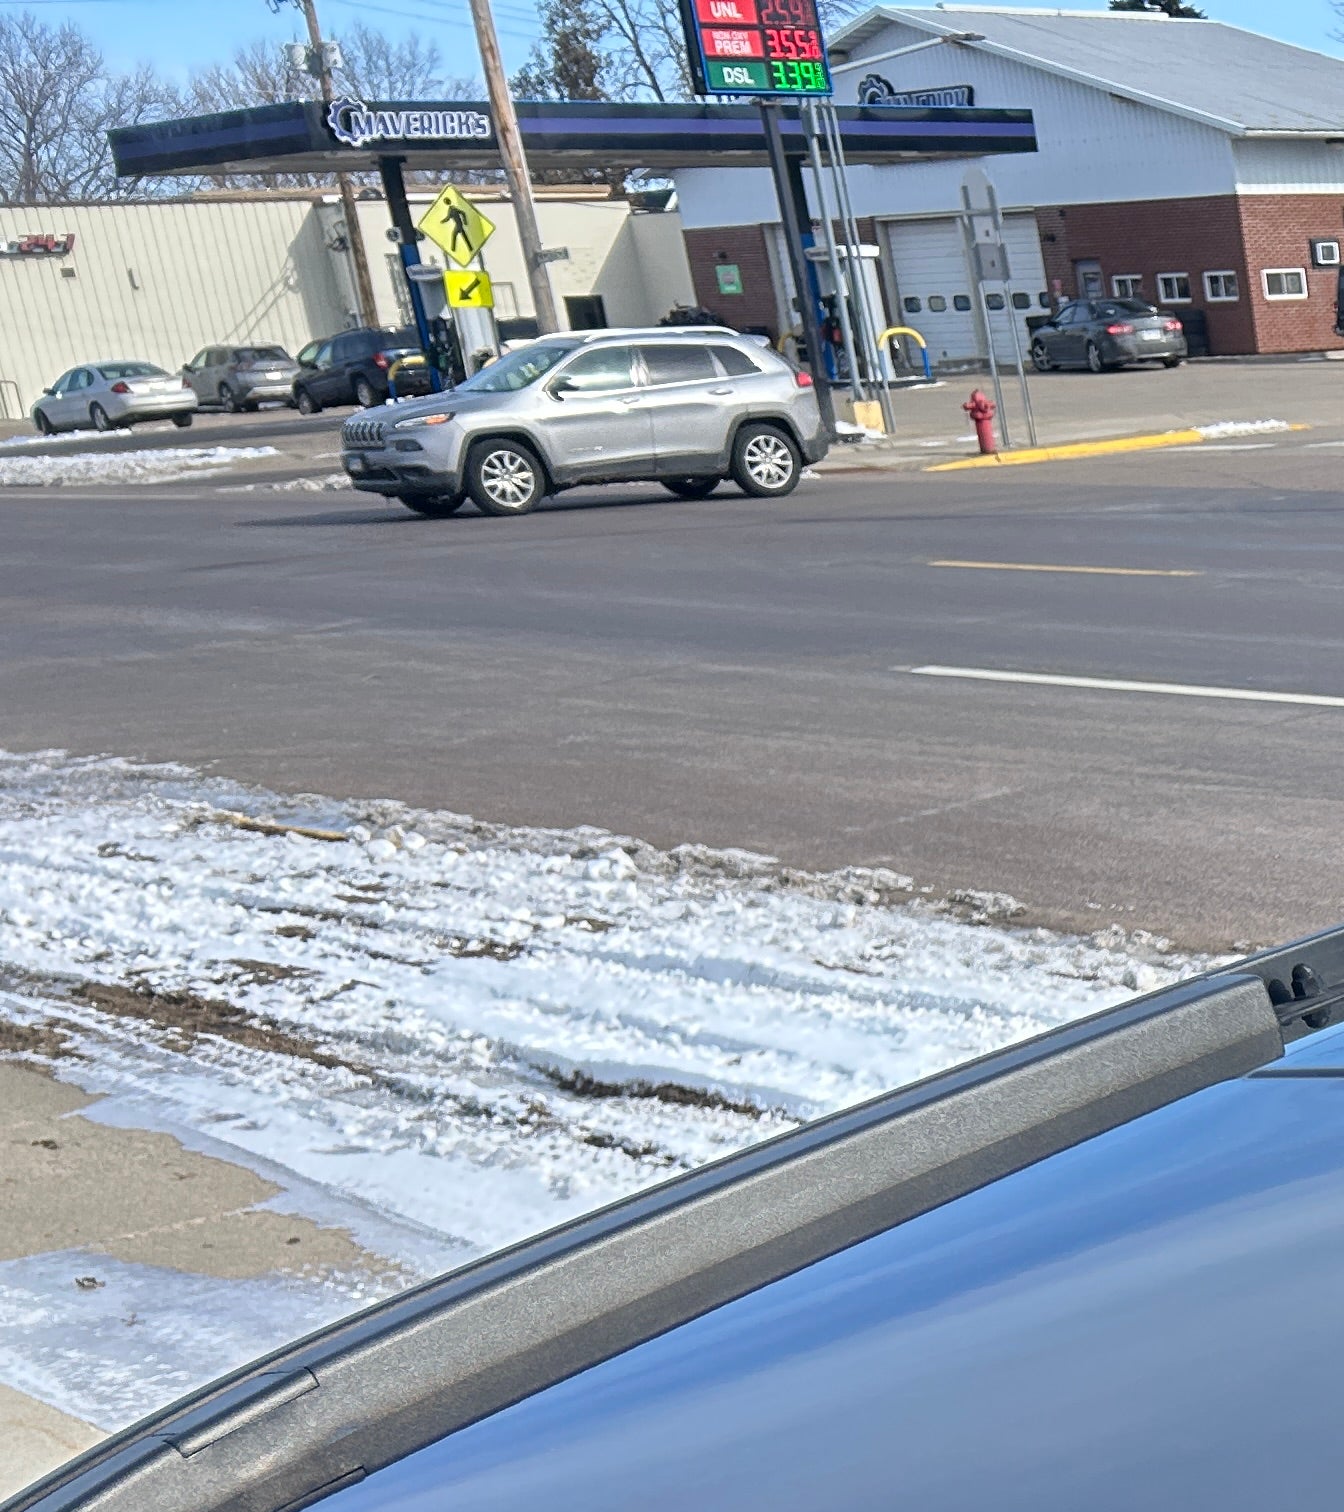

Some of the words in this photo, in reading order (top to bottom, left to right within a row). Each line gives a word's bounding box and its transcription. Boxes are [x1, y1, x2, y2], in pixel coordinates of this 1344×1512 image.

[710, 1, 742, 18] UNL
[715, 40, 752, 55] PREM
[722, 67, 755, 83] DSL
